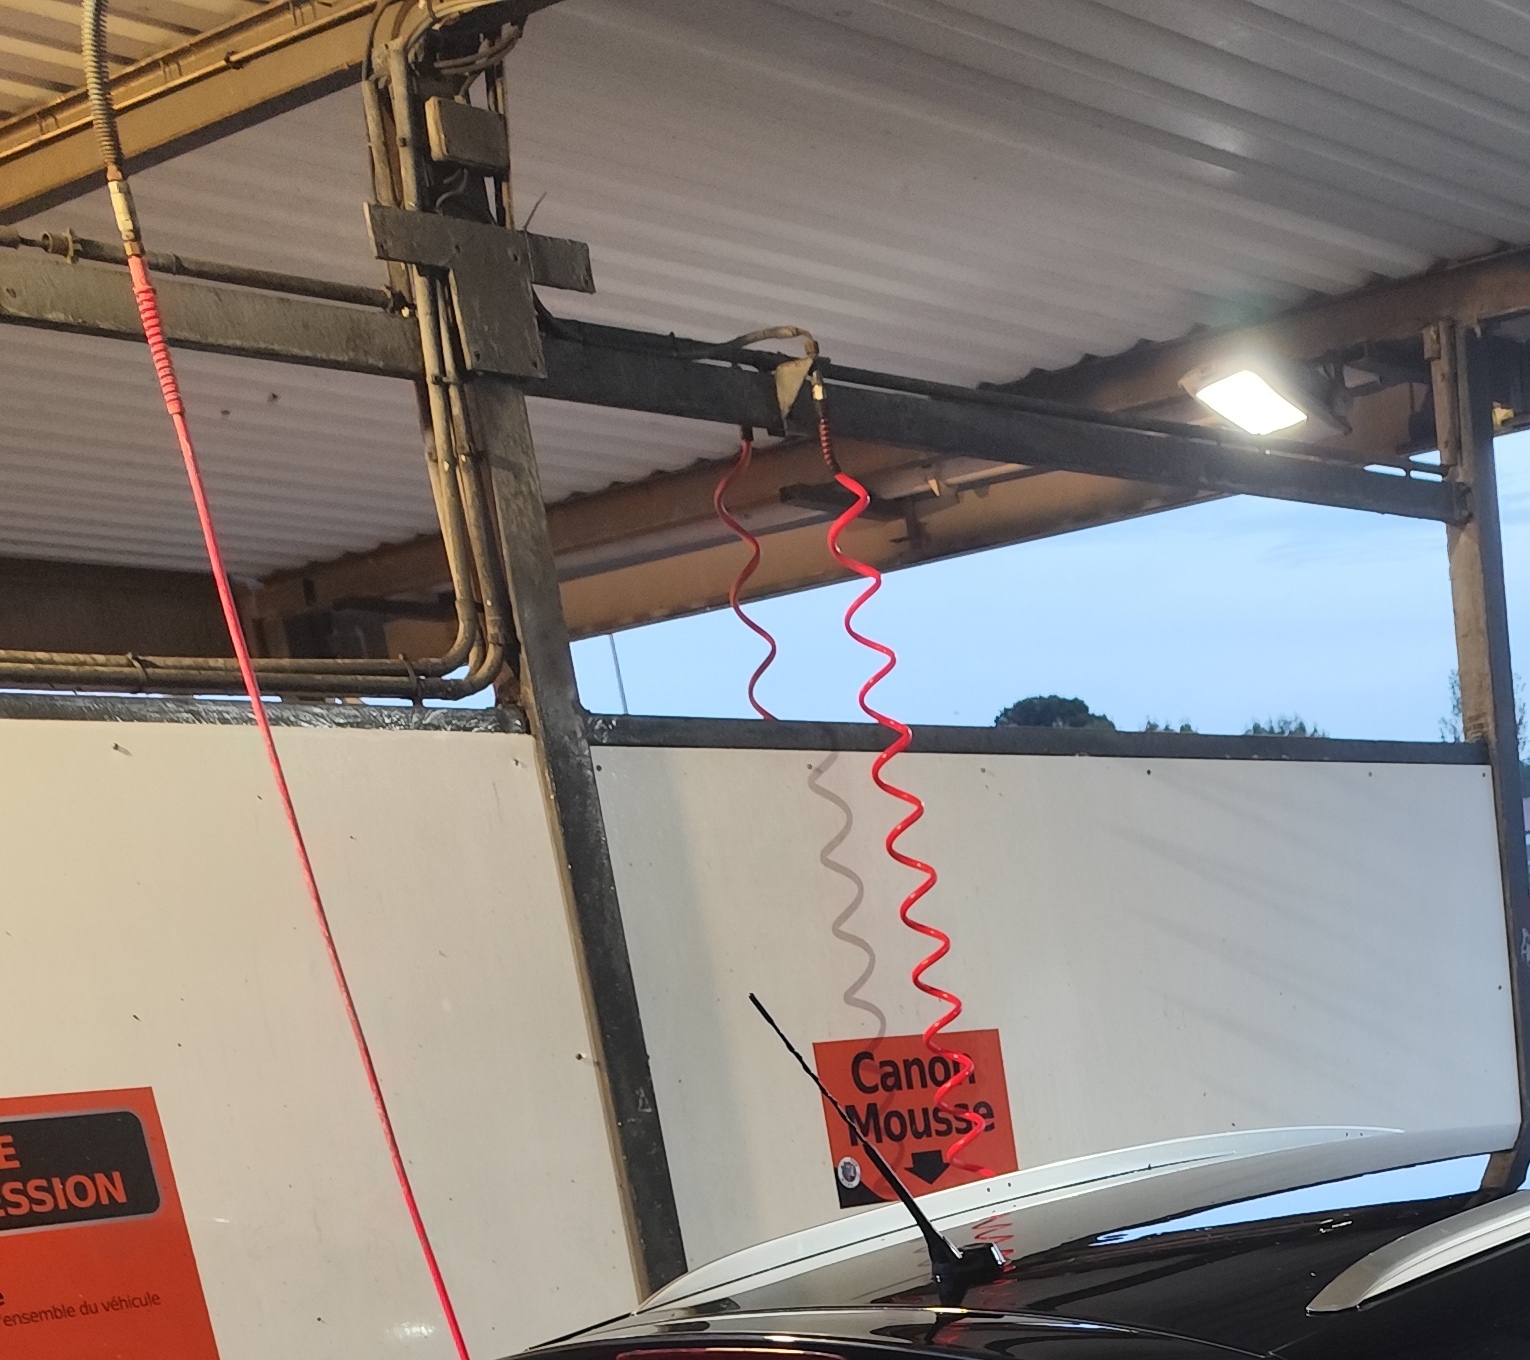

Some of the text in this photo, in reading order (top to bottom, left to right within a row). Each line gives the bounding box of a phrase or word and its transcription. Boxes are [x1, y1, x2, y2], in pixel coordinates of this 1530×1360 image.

[852, 1051, 976, 1094] Canon
[845, 1101, 995, 1147] Mousse
[0, 1171, 127, 1217] SSION
[79, 1301, 99, 1316] du
[101, 1292, 161, 1313] véhicule
